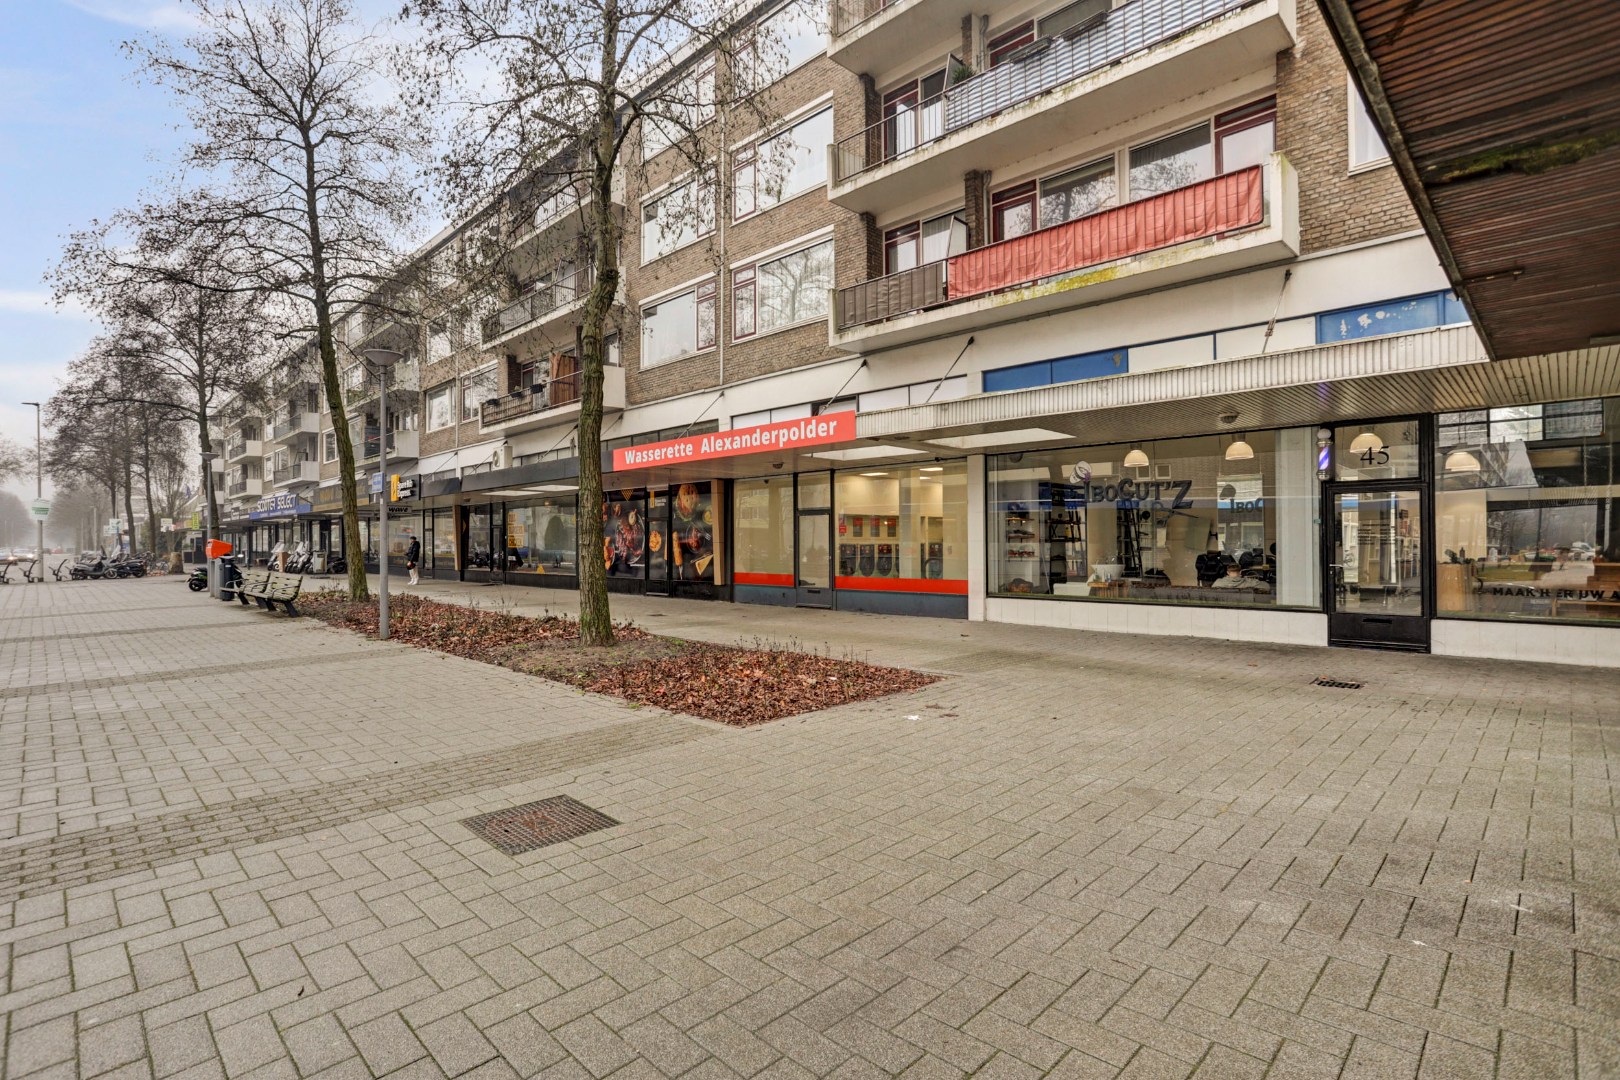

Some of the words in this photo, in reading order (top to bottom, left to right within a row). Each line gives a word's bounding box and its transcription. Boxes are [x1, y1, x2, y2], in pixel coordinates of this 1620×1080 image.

[624, 442, 693, 465] Wasserette
[700, 417, 838, 454] Alexanderpolder
[1360, 446, 1390, 465] 45
[1492, 587, 1536, 597] MAAK
[1539, 588, 1574, 598] HER
